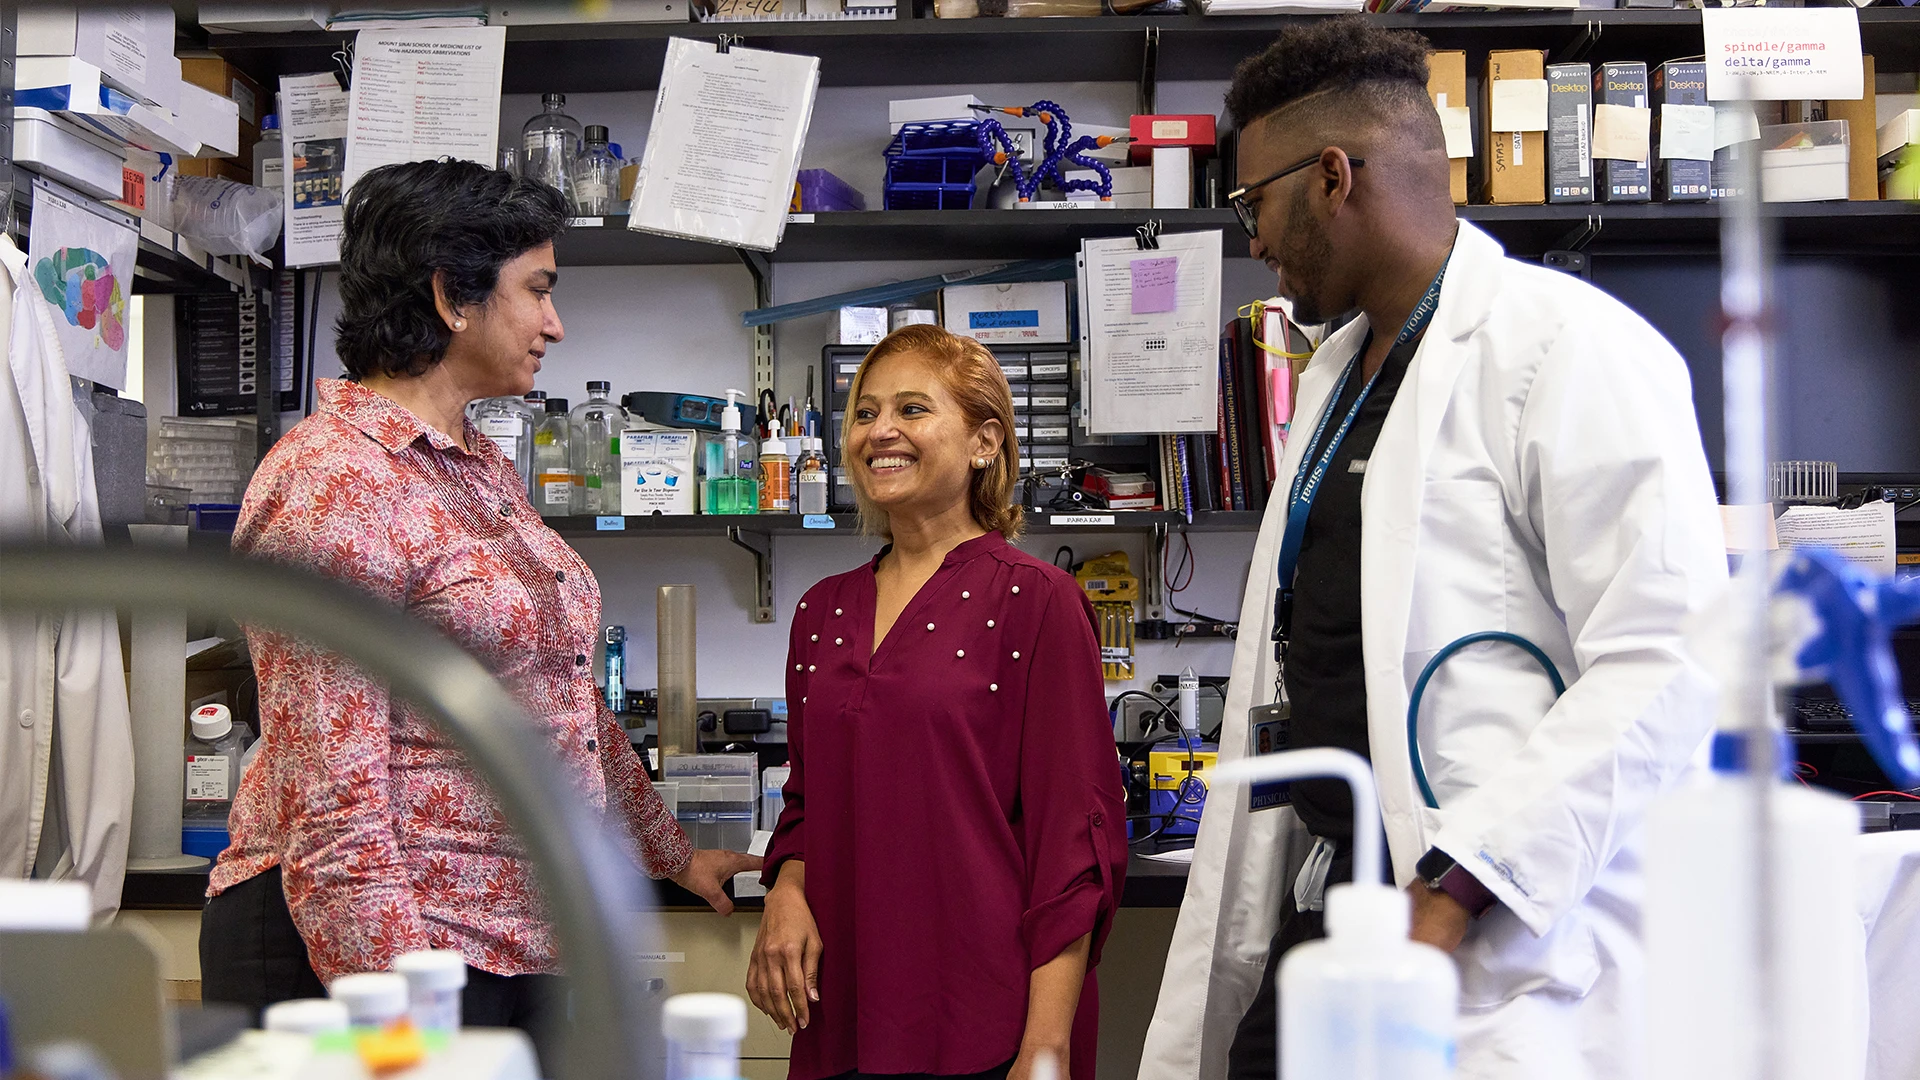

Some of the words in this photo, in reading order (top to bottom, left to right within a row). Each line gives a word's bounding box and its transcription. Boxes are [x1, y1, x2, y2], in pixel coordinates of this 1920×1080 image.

[1724, 41, 1826, 53] spindle/gamma
[1724, 57, 1811, 69] delta/gamma
[1551, 83, 1588, 94] Desktop
[1608, 81, 1644, 92] Desktop
[1669, 80, 1705, 91] Desktop
[1226, 382, 1234, 396] THE
[1227, 397, 1236, 423] HUMAN
[1229, 424, 1239, 457] NERVOUS
[1320, 418, 1349, 466] Mount
[1232, 458, 1241, 484] SYSTEM
[1300, 465, 1324, 504] Sinai
[1252, 790, 1292, 808] PHYSICIAN
